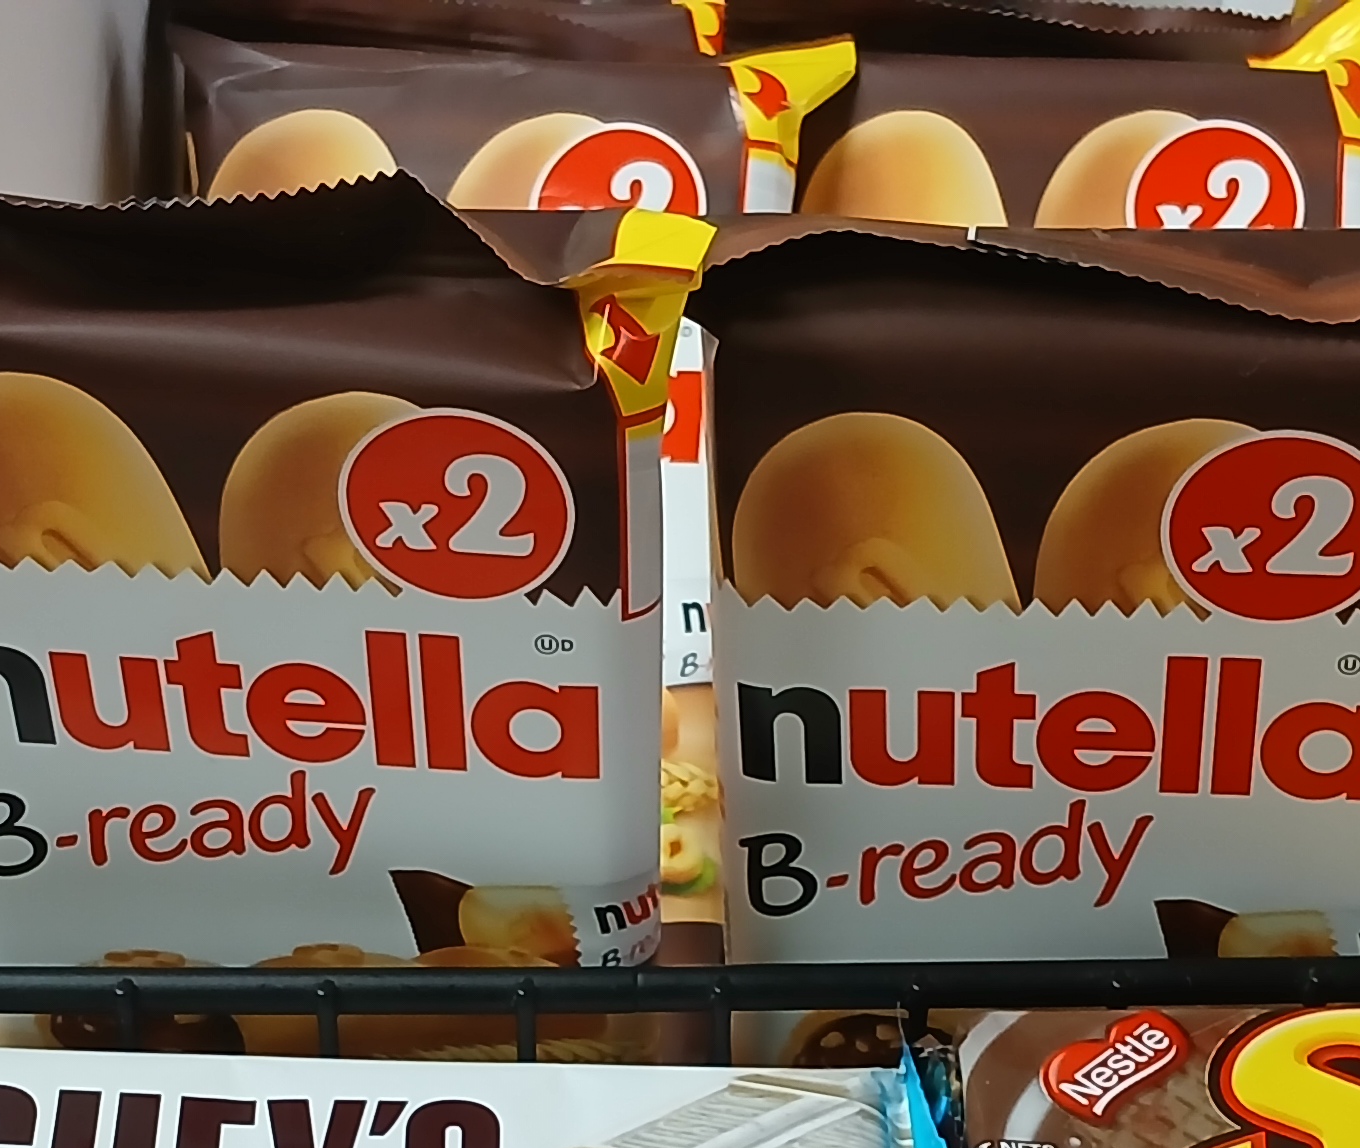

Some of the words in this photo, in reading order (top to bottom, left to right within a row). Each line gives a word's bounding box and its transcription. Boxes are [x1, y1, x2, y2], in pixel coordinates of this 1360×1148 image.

[375, 453, 536, 559] x2
[1191, 474, 1356, 578] x2
[737, 798, 1155, 918] B-ready
